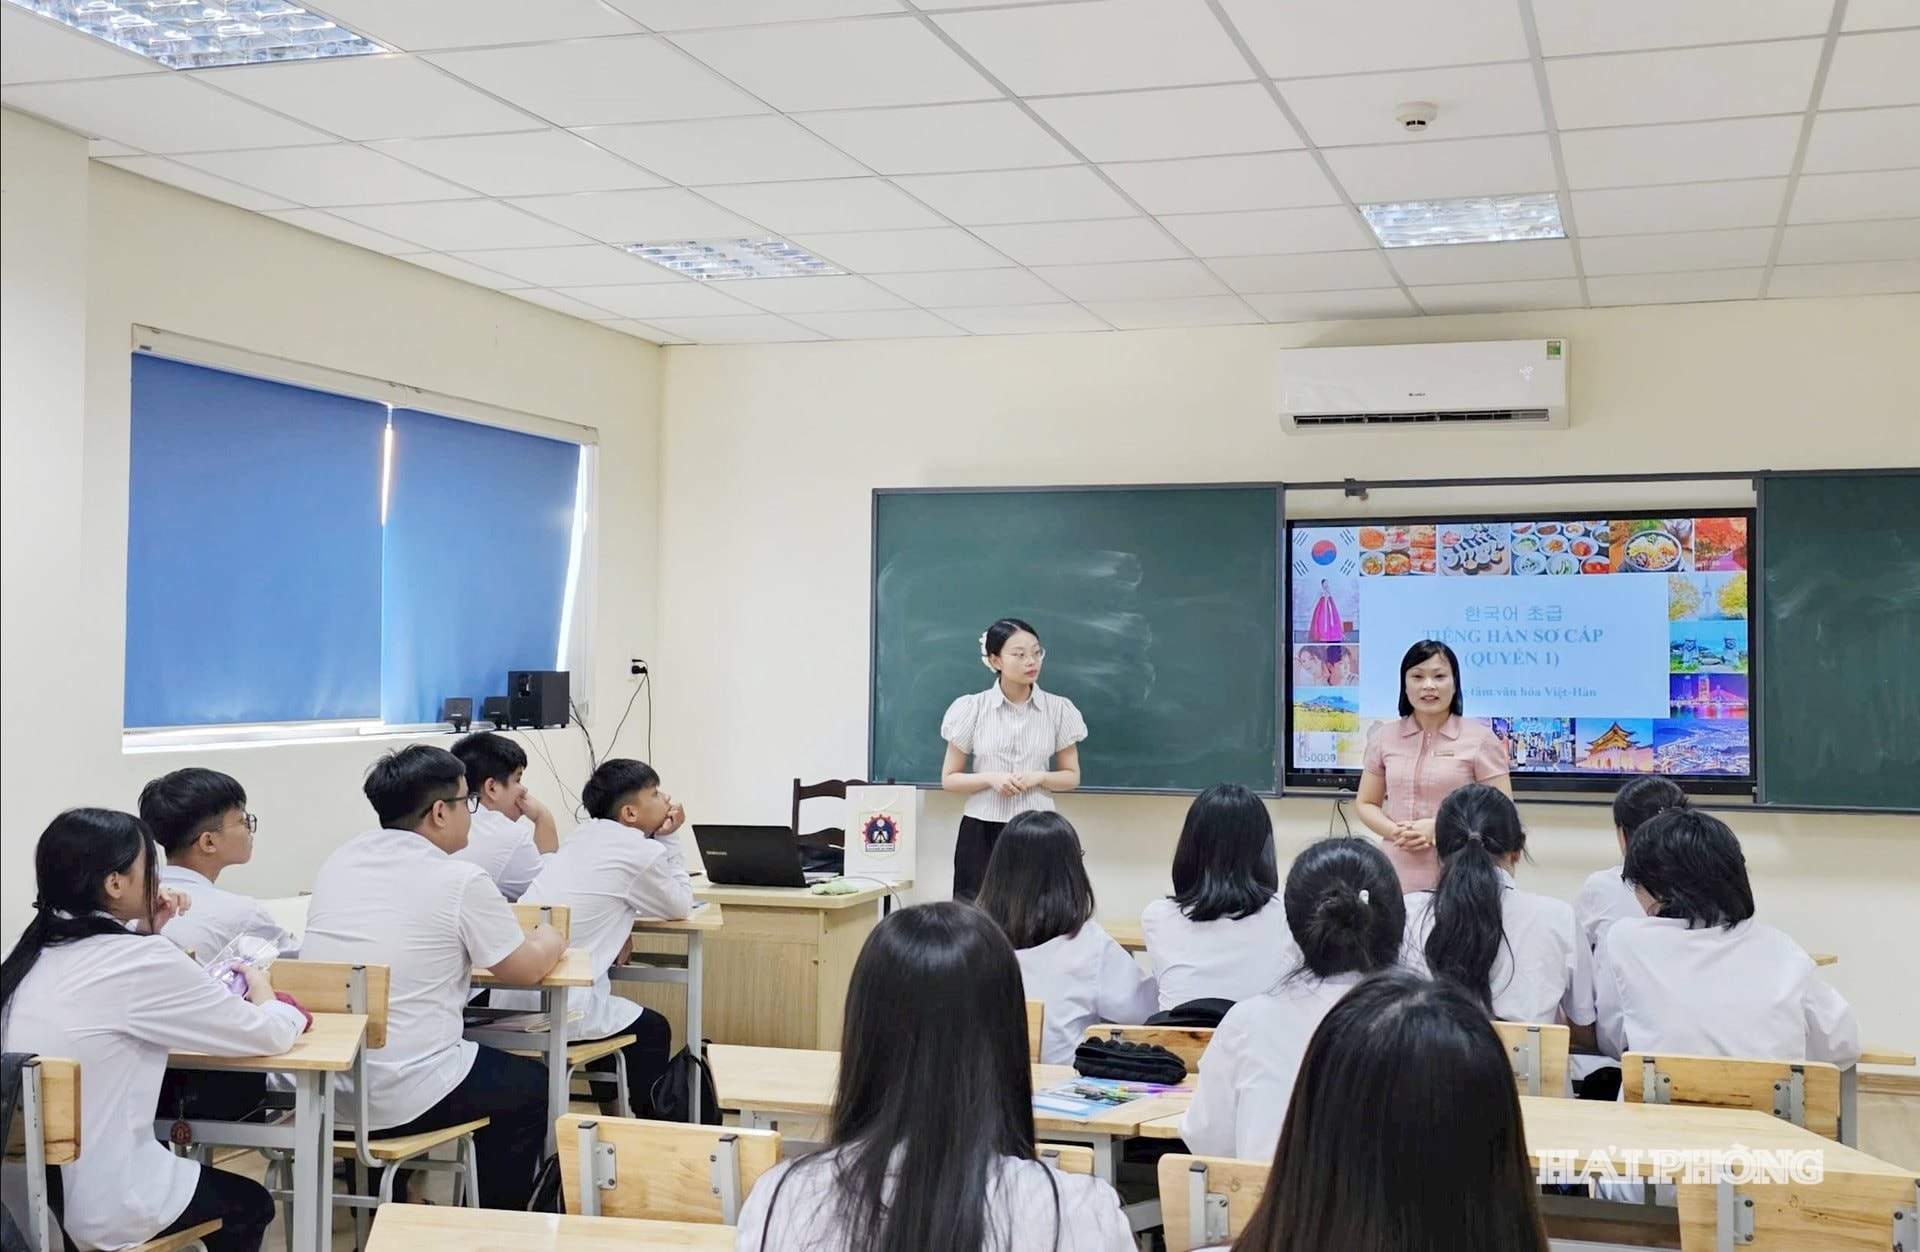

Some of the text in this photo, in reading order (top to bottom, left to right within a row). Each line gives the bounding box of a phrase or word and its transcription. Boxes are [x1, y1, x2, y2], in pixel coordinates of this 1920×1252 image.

[1464, 605, 1563, 622] 한국어 초급
[1486, 625, 1528, 643] HÀN
[1533, 627, 1560, 643] SƠ
[1545, 651, 1560, 668] 1)
[1303, 752, 1336, 763] 50000
